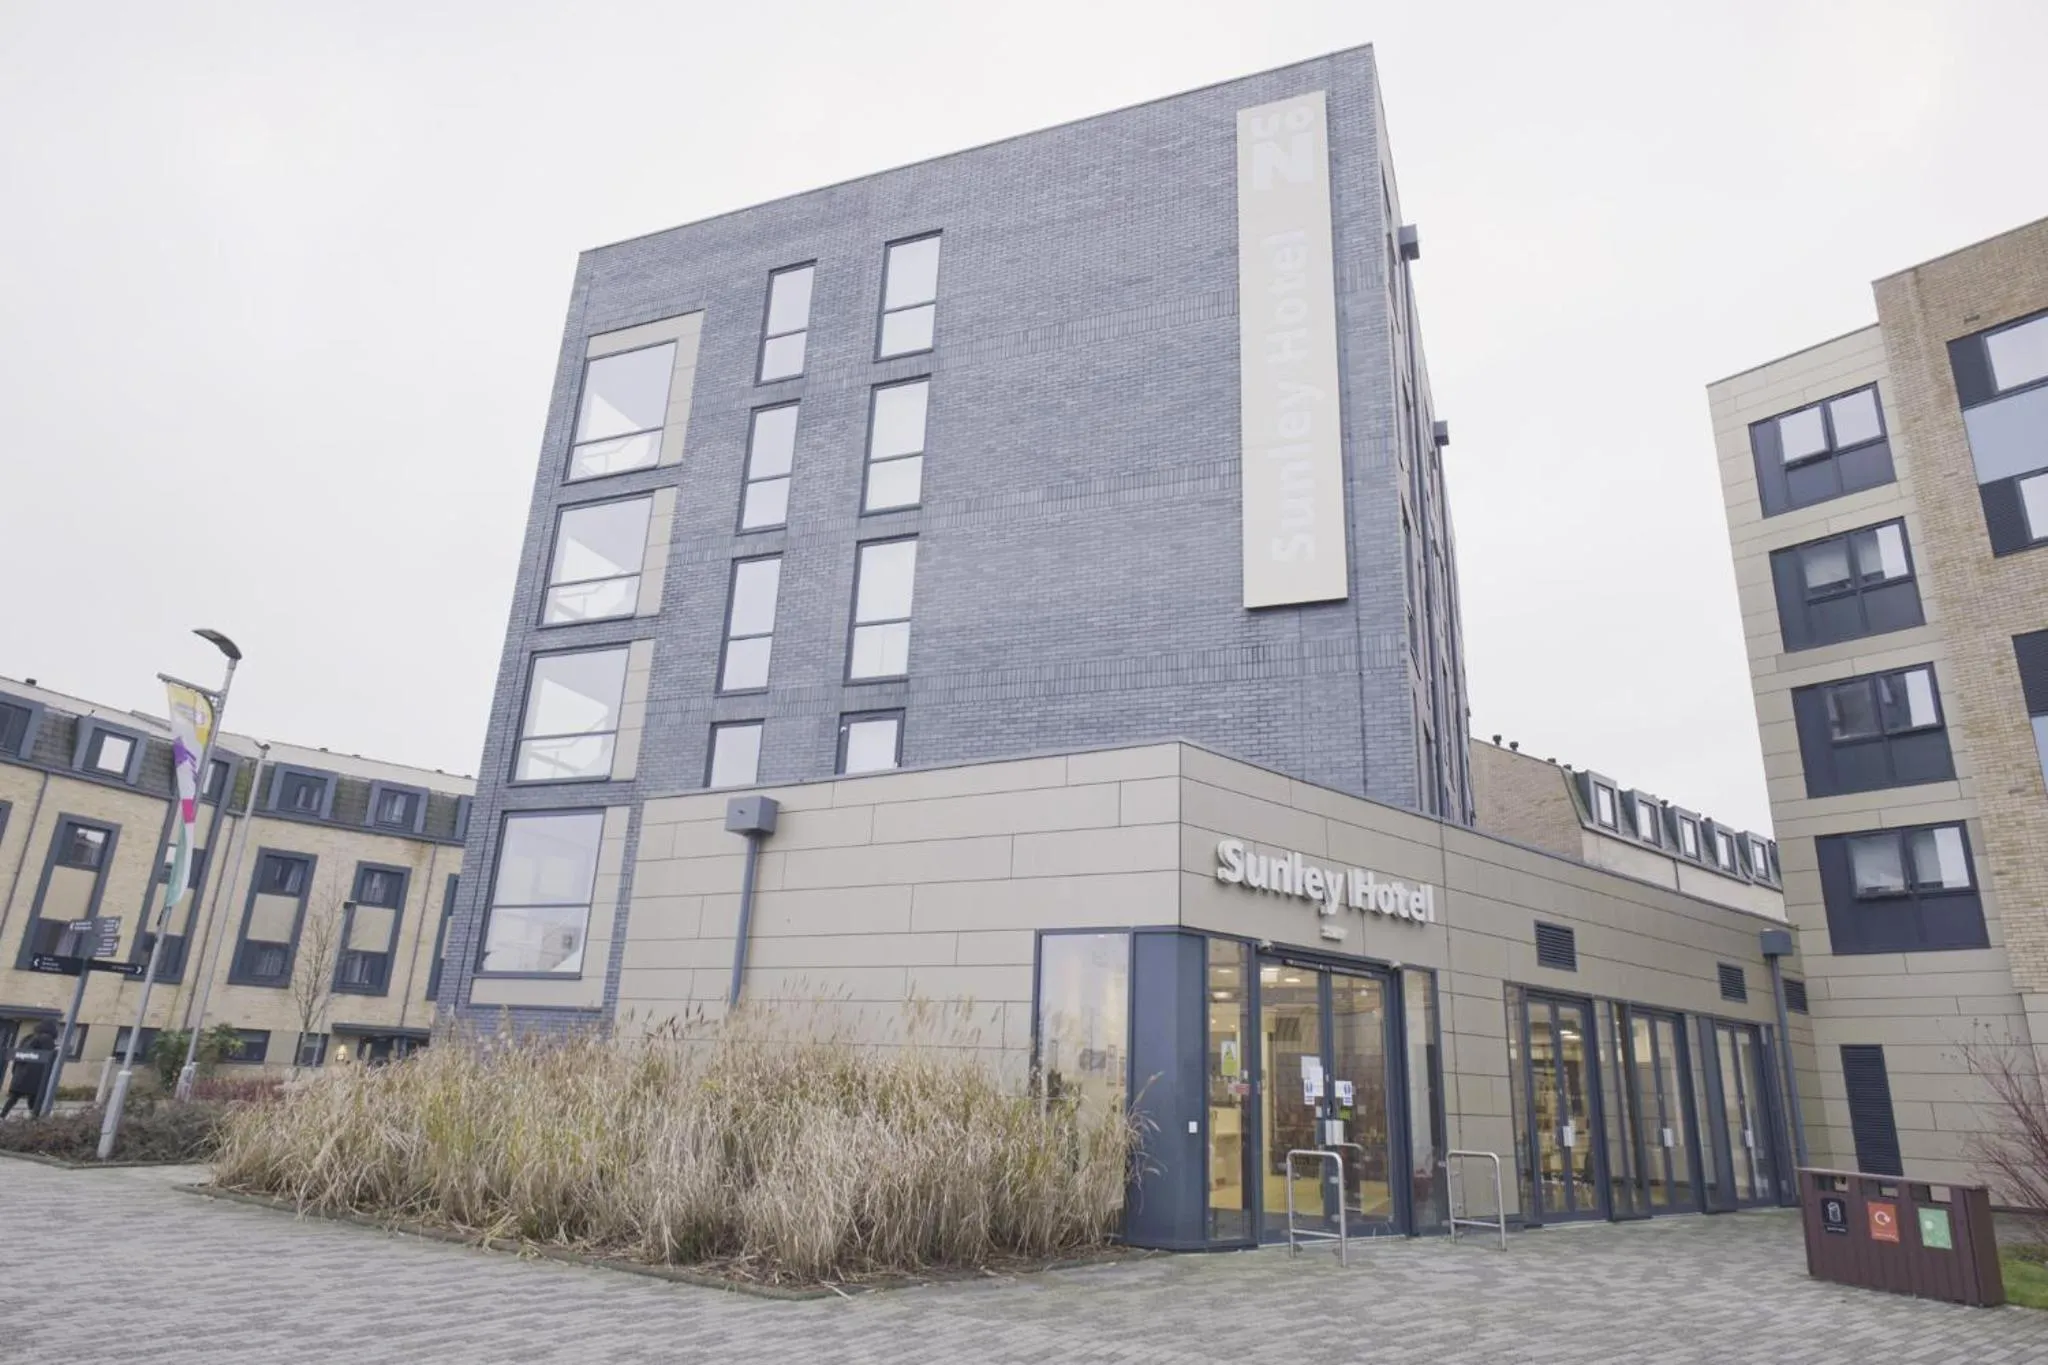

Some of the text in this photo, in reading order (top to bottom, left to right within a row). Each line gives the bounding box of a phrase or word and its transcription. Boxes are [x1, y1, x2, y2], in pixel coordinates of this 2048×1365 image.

[1262, 230, 1325, 561] Sunley Hotel
[1217, 839, 1435, 922] Sunley Hotel
